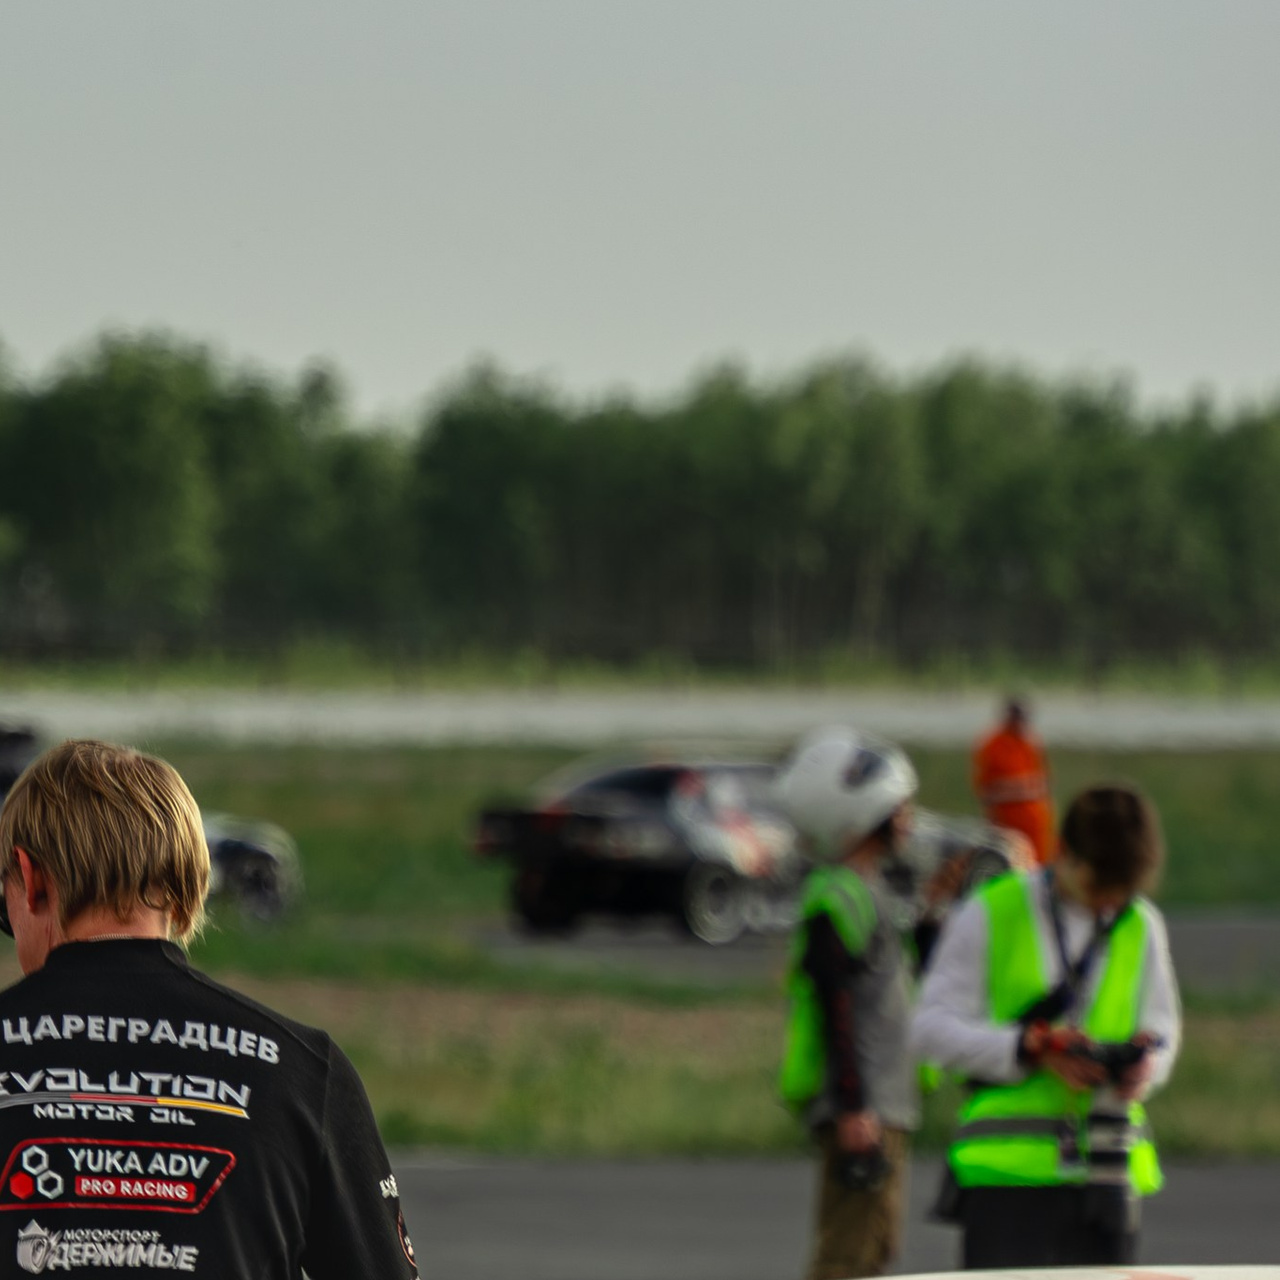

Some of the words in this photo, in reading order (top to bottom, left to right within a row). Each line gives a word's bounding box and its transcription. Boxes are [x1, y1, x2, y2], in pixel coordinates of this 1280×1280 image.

[1, 1014, 281, 1065] ЦАРЕГРАДЦЕВ
[32, 1102, 136, 1123] MOTOR
[149, 1107, 197, 1126] OIL
[67, 1147, 145, 1175] YUKA
[147, 1151, 211, 1180] ADV
[80, 1177, 116, 1195] PRO
[119, 1179, 189, 1200] RACING
[62, 1228, 162, 1243] МОТОРСПОРТ
